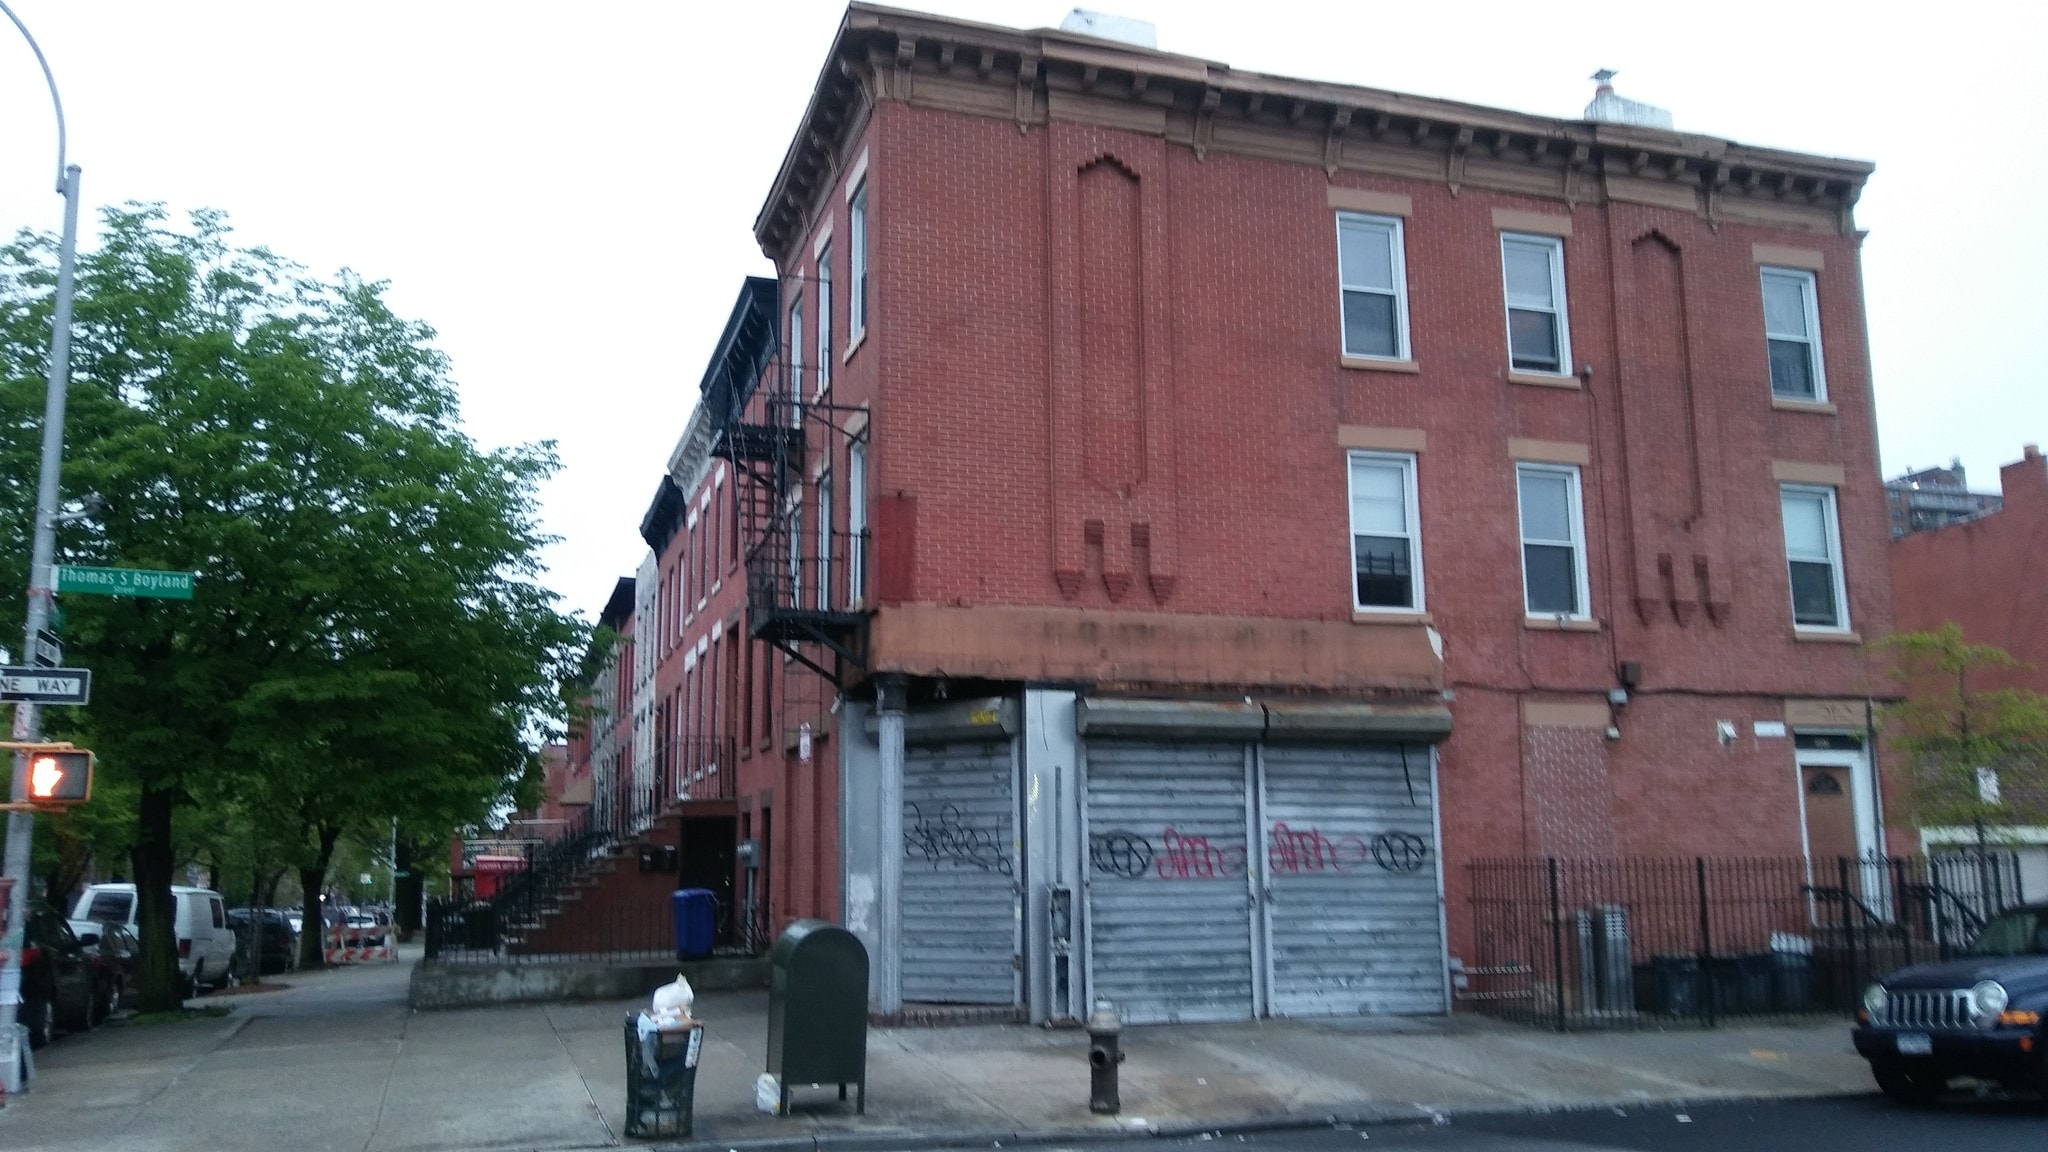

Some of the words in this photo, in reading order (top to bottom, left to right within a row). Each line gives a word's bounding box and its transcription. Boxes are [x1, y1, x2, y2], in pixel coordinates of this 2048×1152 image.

[62, 567, 115, 585] Thomas
[119, 571, 128, 586] S
[133, 573, 189, 591] Boyland
[112, 586, 136, 594] Street
[0, 678, 20, 692] NE
[37, 679, 73, 692] WAY
